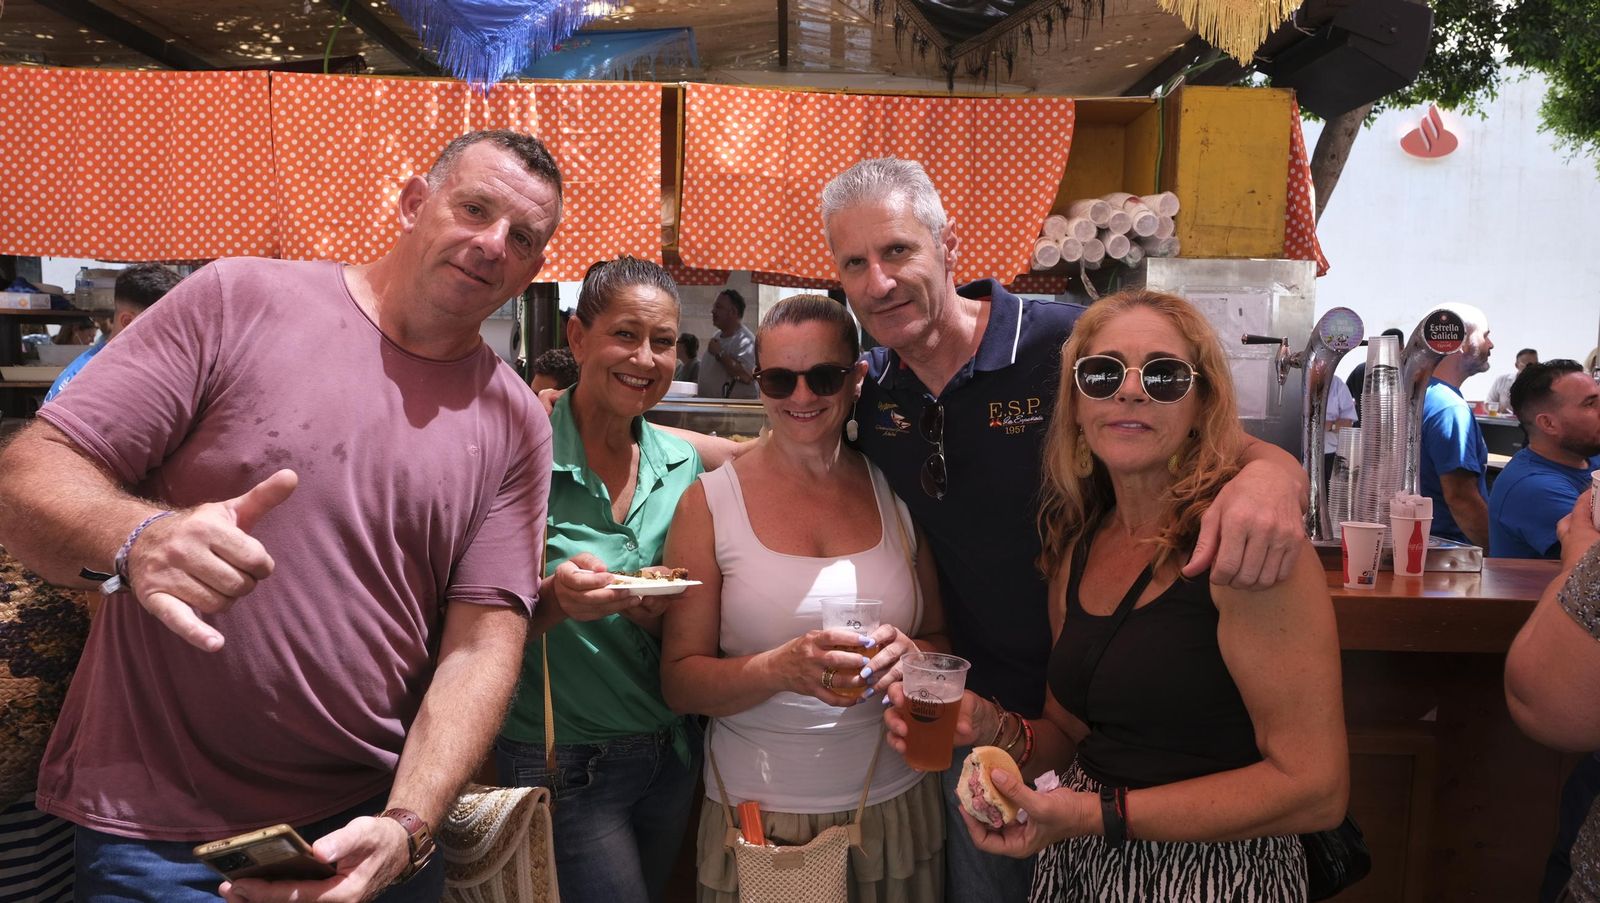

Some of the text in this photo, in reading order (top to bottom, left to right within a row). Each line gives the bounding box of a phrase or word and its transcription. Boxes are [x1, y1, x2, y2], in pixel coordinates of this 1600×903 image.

[1430, 323, 1459, 331] Estrella
[1430, 331, 1458, 340] Galicia
[1005, 425, 1026, 434] 1957
